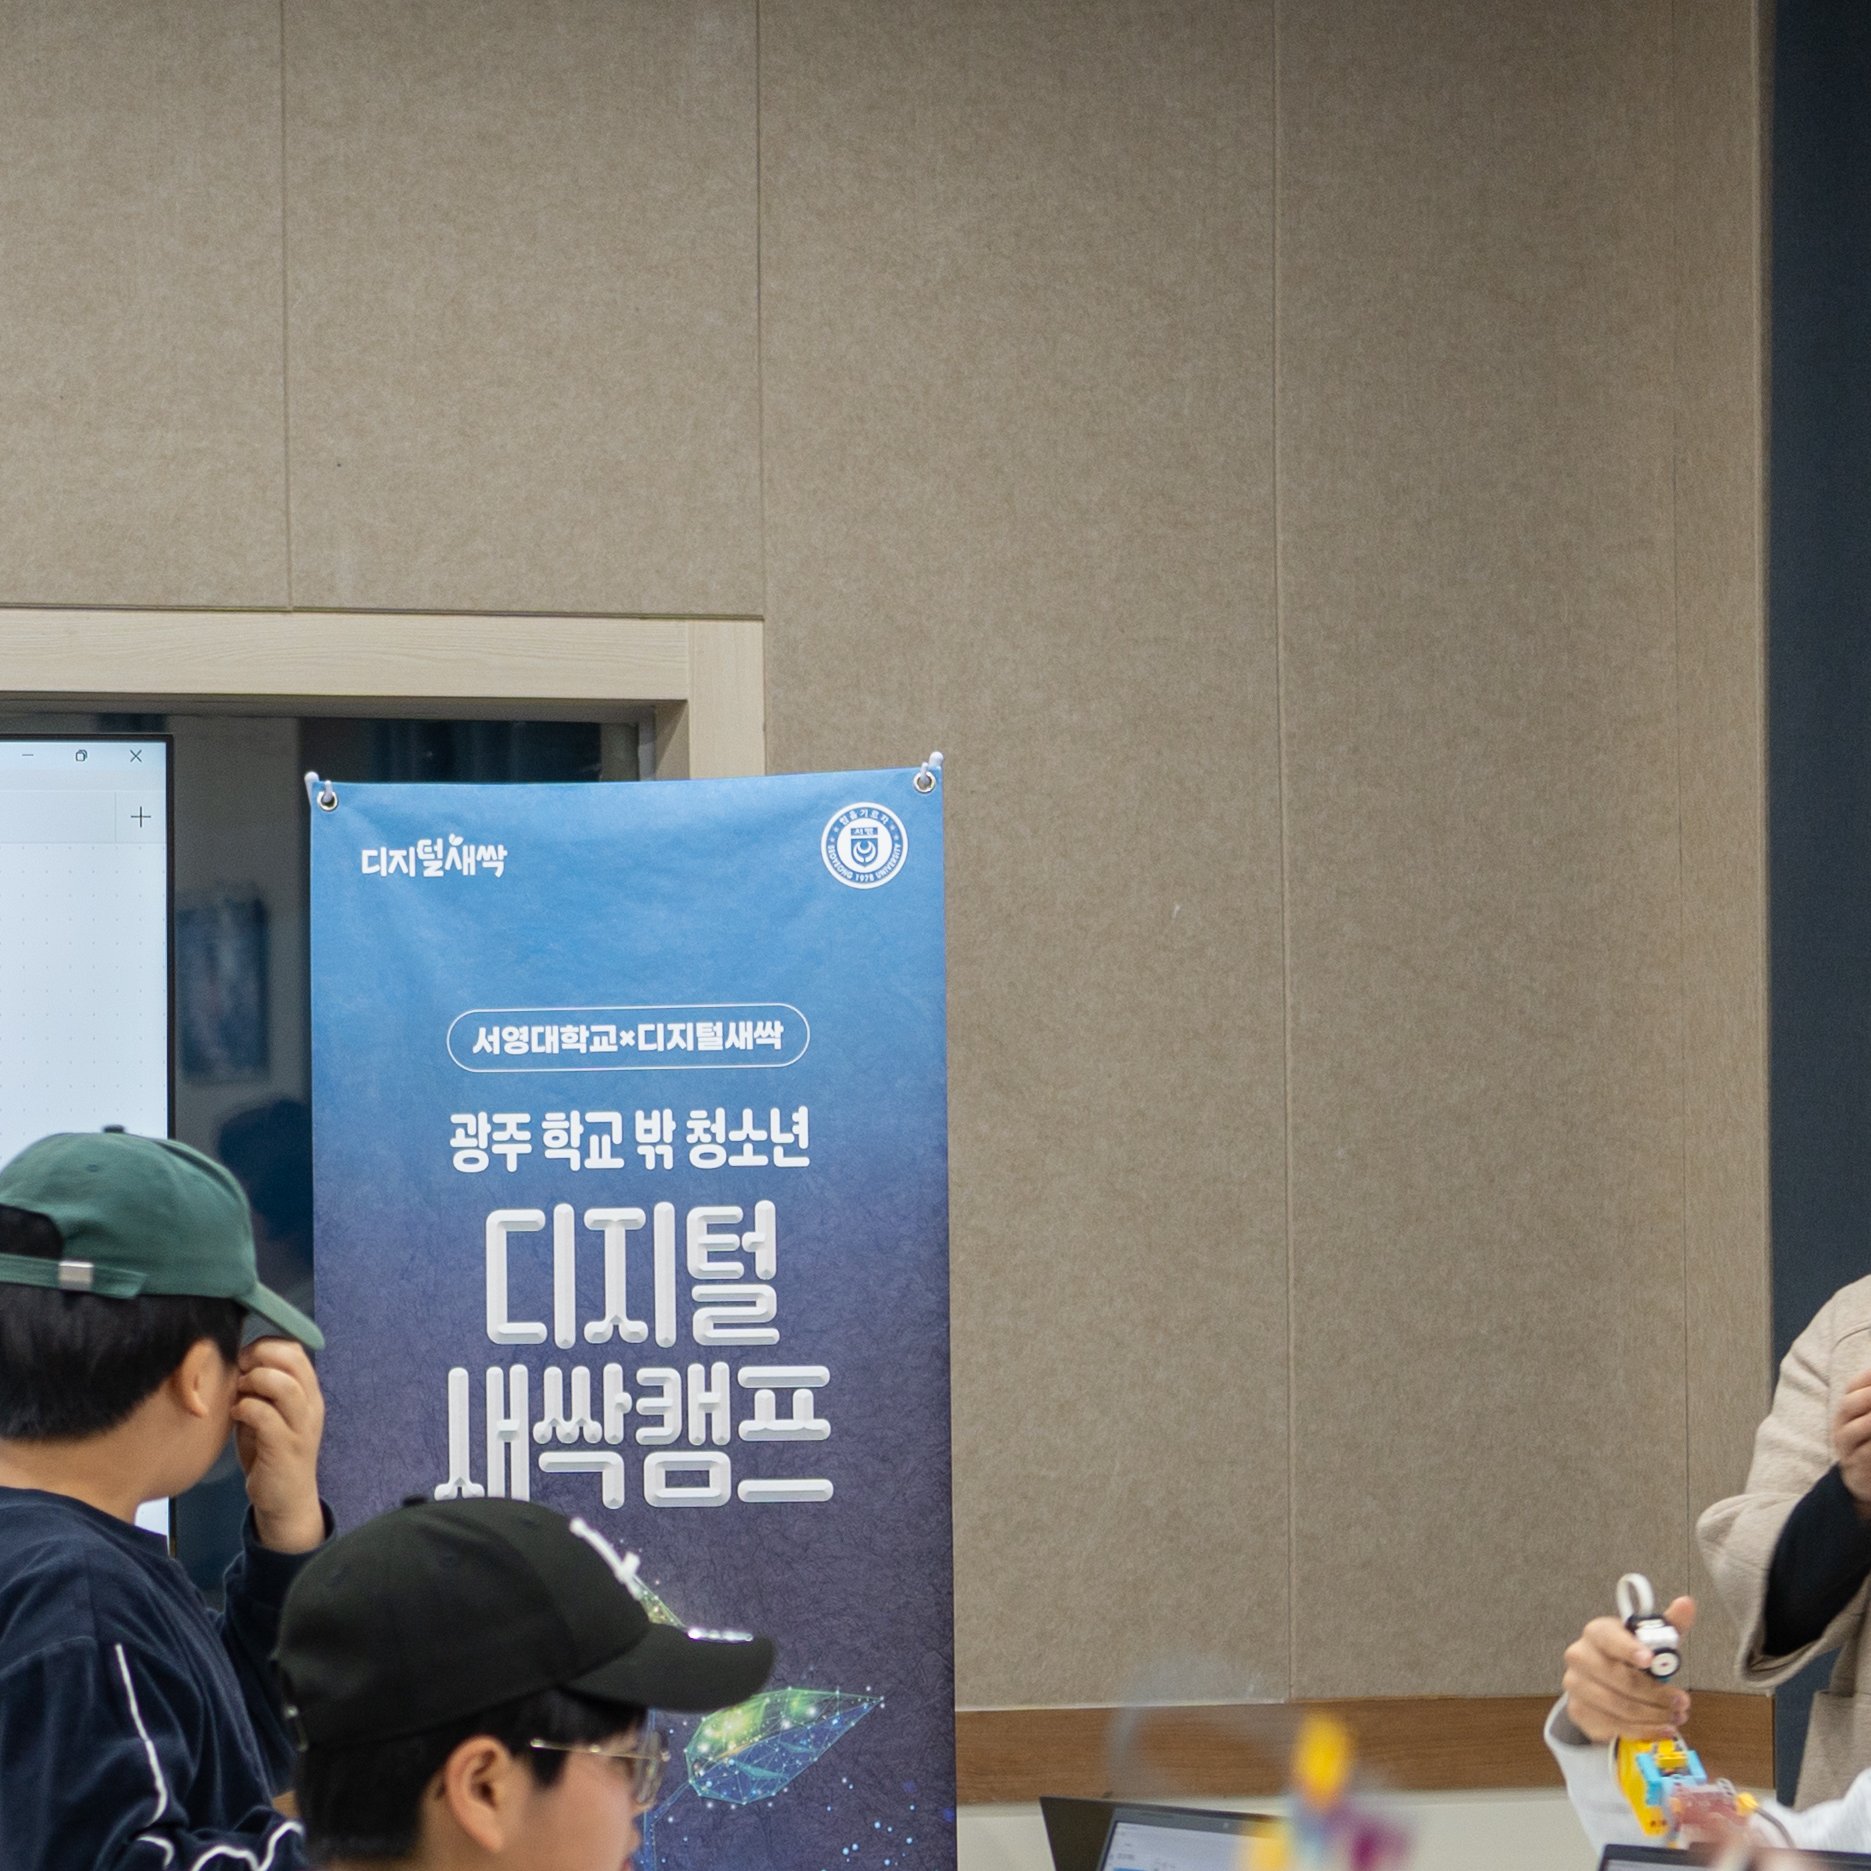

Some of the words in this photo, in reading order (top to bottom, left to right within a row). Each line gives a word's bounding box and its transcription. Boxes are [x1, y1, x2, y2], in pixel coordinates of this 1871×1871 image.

[450, 1112, 532, 1173] 광주
[541, 1110, 625, 1171] 학교
[634, 1108, 675, 1170] 밖
[685, 1106, 810, 1169] 청소년
[485, 1200, 780, 1349] 디지털
[434, 1361, 834, 1510] 새싹캠프
